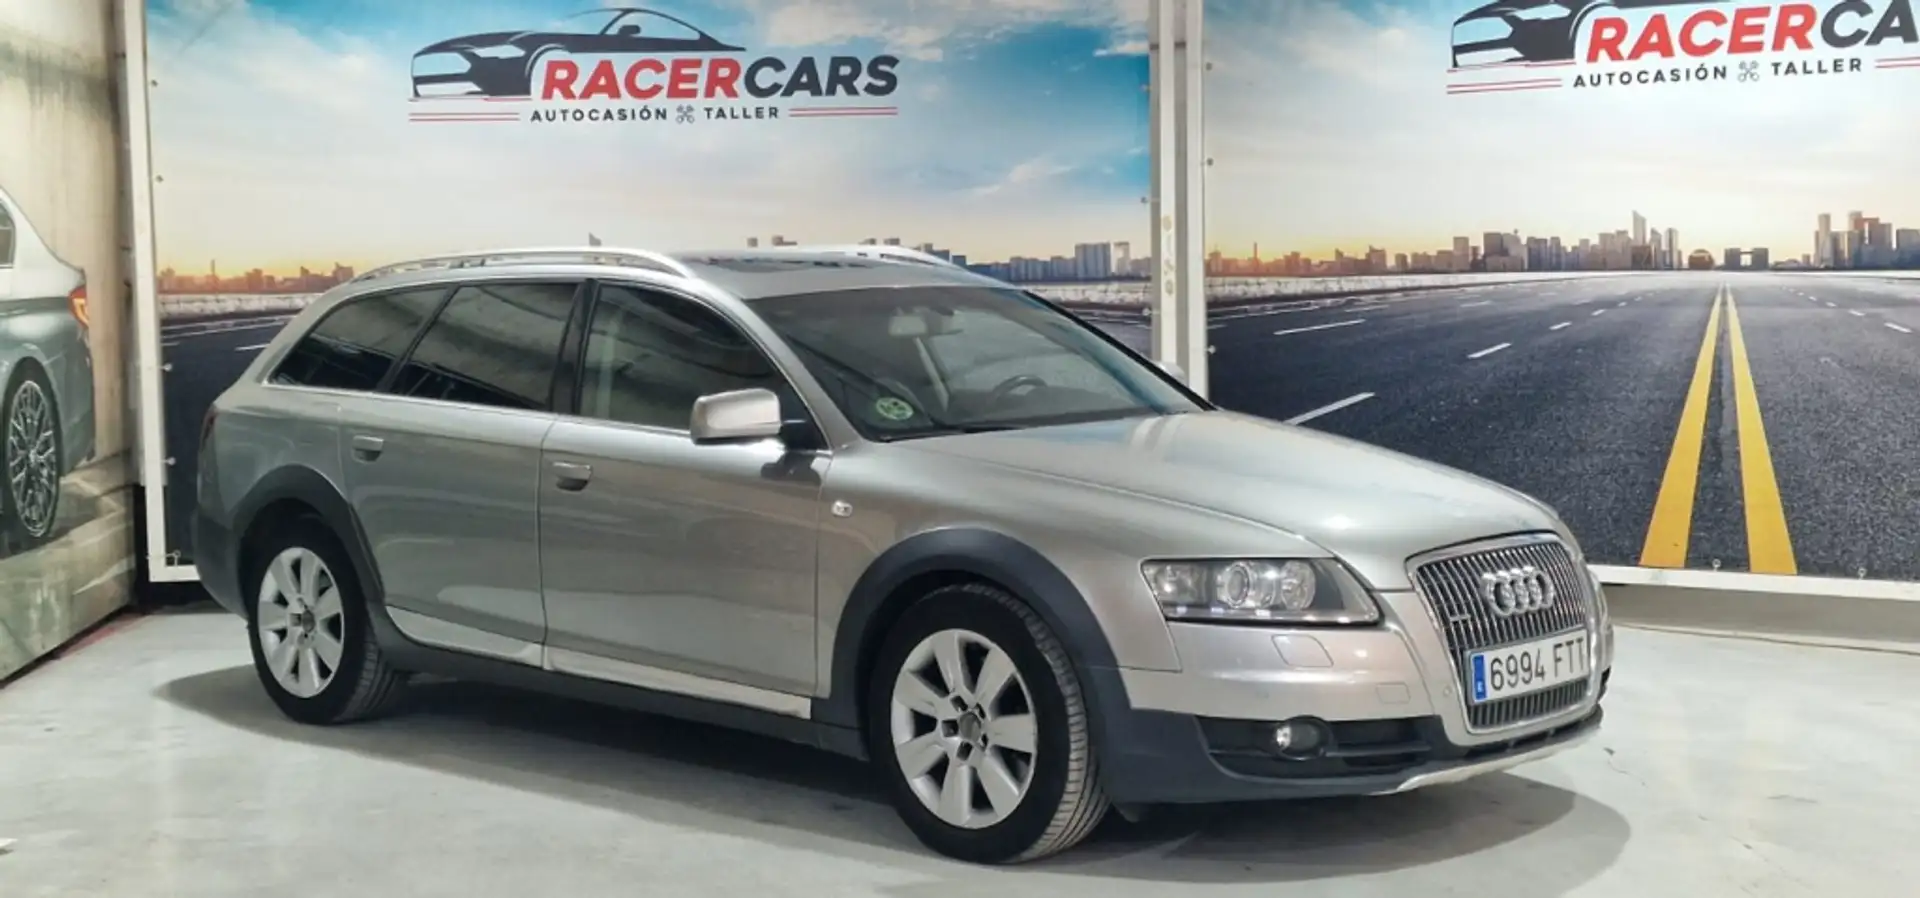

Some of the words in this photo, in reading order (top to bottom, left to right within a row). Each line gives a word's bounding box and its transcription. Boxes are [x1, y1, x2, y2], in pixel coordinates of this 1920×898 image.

[540, 55, 899, 101] RACERCARS
[1572, 63, 1728, 88] AUTOCASIÓN
[1771, 58, 1863, 77] TALLER
[530, 104, 667, 122] AUTOCASIÓN
[703, 106, 780, 120] TALLER
[1490, 648, 1546, 692] 6994
[1553, 637, 1585, 678] FTT
